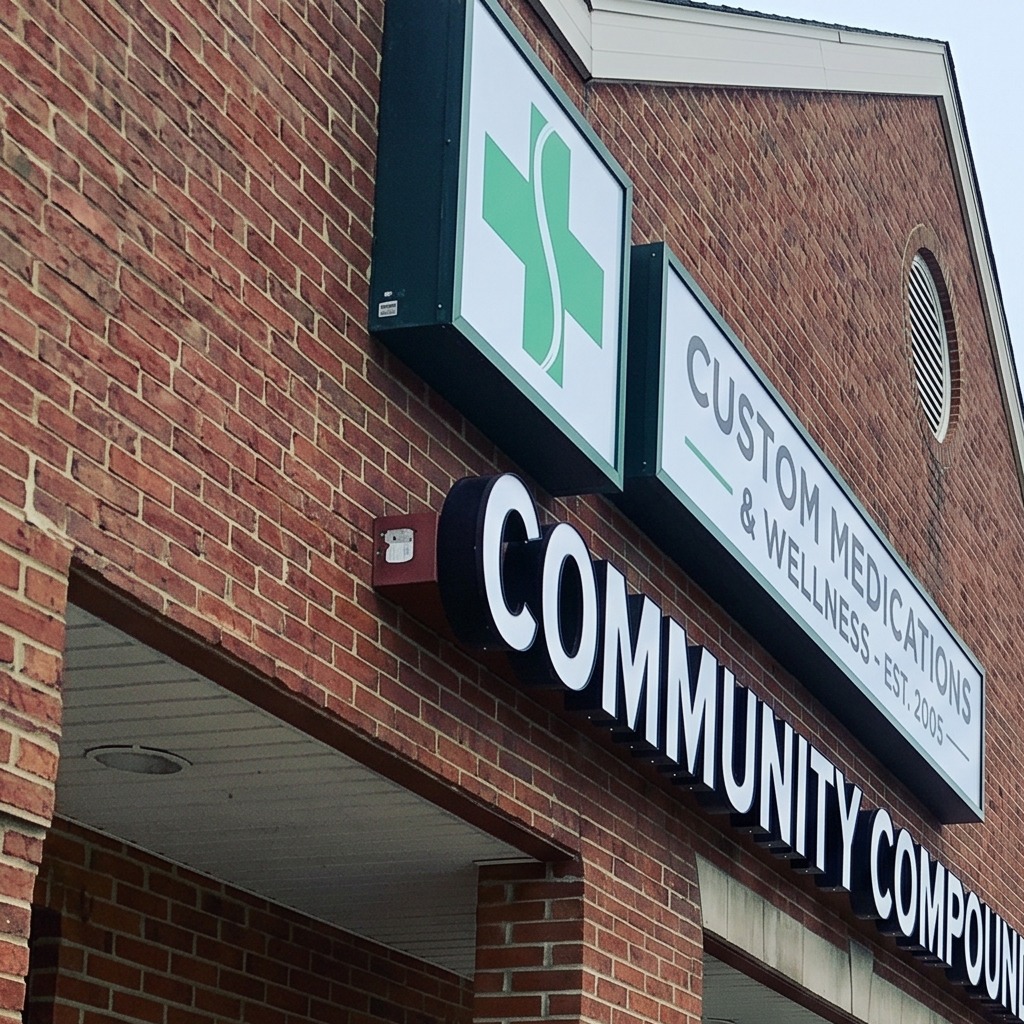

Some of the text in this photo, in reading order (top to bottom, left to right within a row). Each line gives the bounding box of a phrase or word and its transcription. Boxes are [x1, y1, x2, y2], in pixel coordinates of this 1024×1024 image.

[483, 472, 863, 892] COMMUNITY
[686, 335, 971, 725] CUSTOM MEDICATIONS
[740, 488, 755, 541] &
[763, 507, 870, 665] WELLNESS
[884, 652, 911, 711] EST.
[914, 688, 943, 746] 2005
